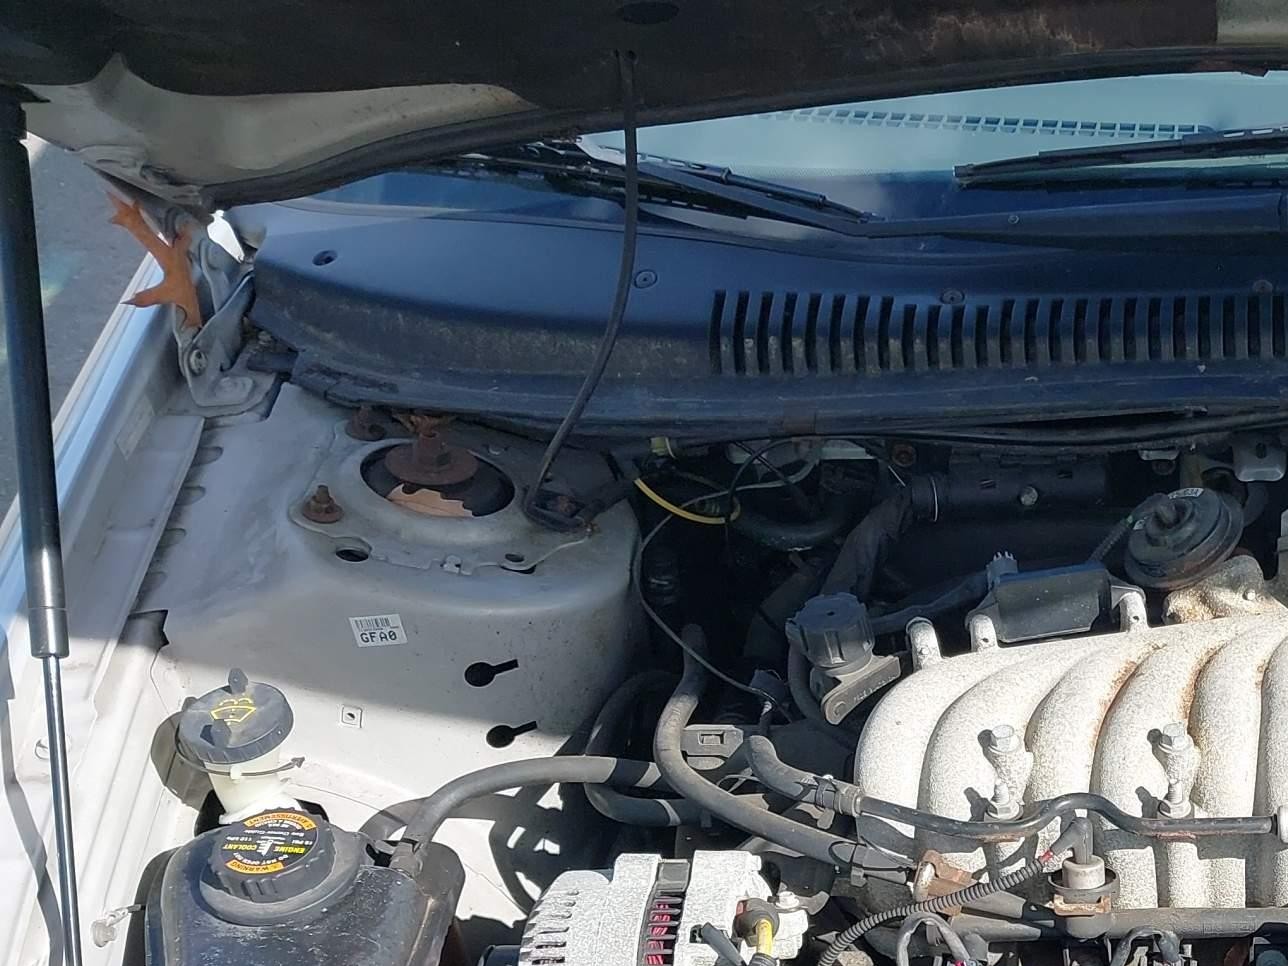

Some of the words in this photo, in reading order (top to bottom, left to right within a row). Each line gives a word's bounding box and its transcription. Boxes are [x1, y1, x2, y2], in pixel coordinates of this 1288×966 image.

[223, 843, 257, 851] COOLANT
[273, 846, 305, 854] ENGINE
[230, 860, 269, 871] WARNING
